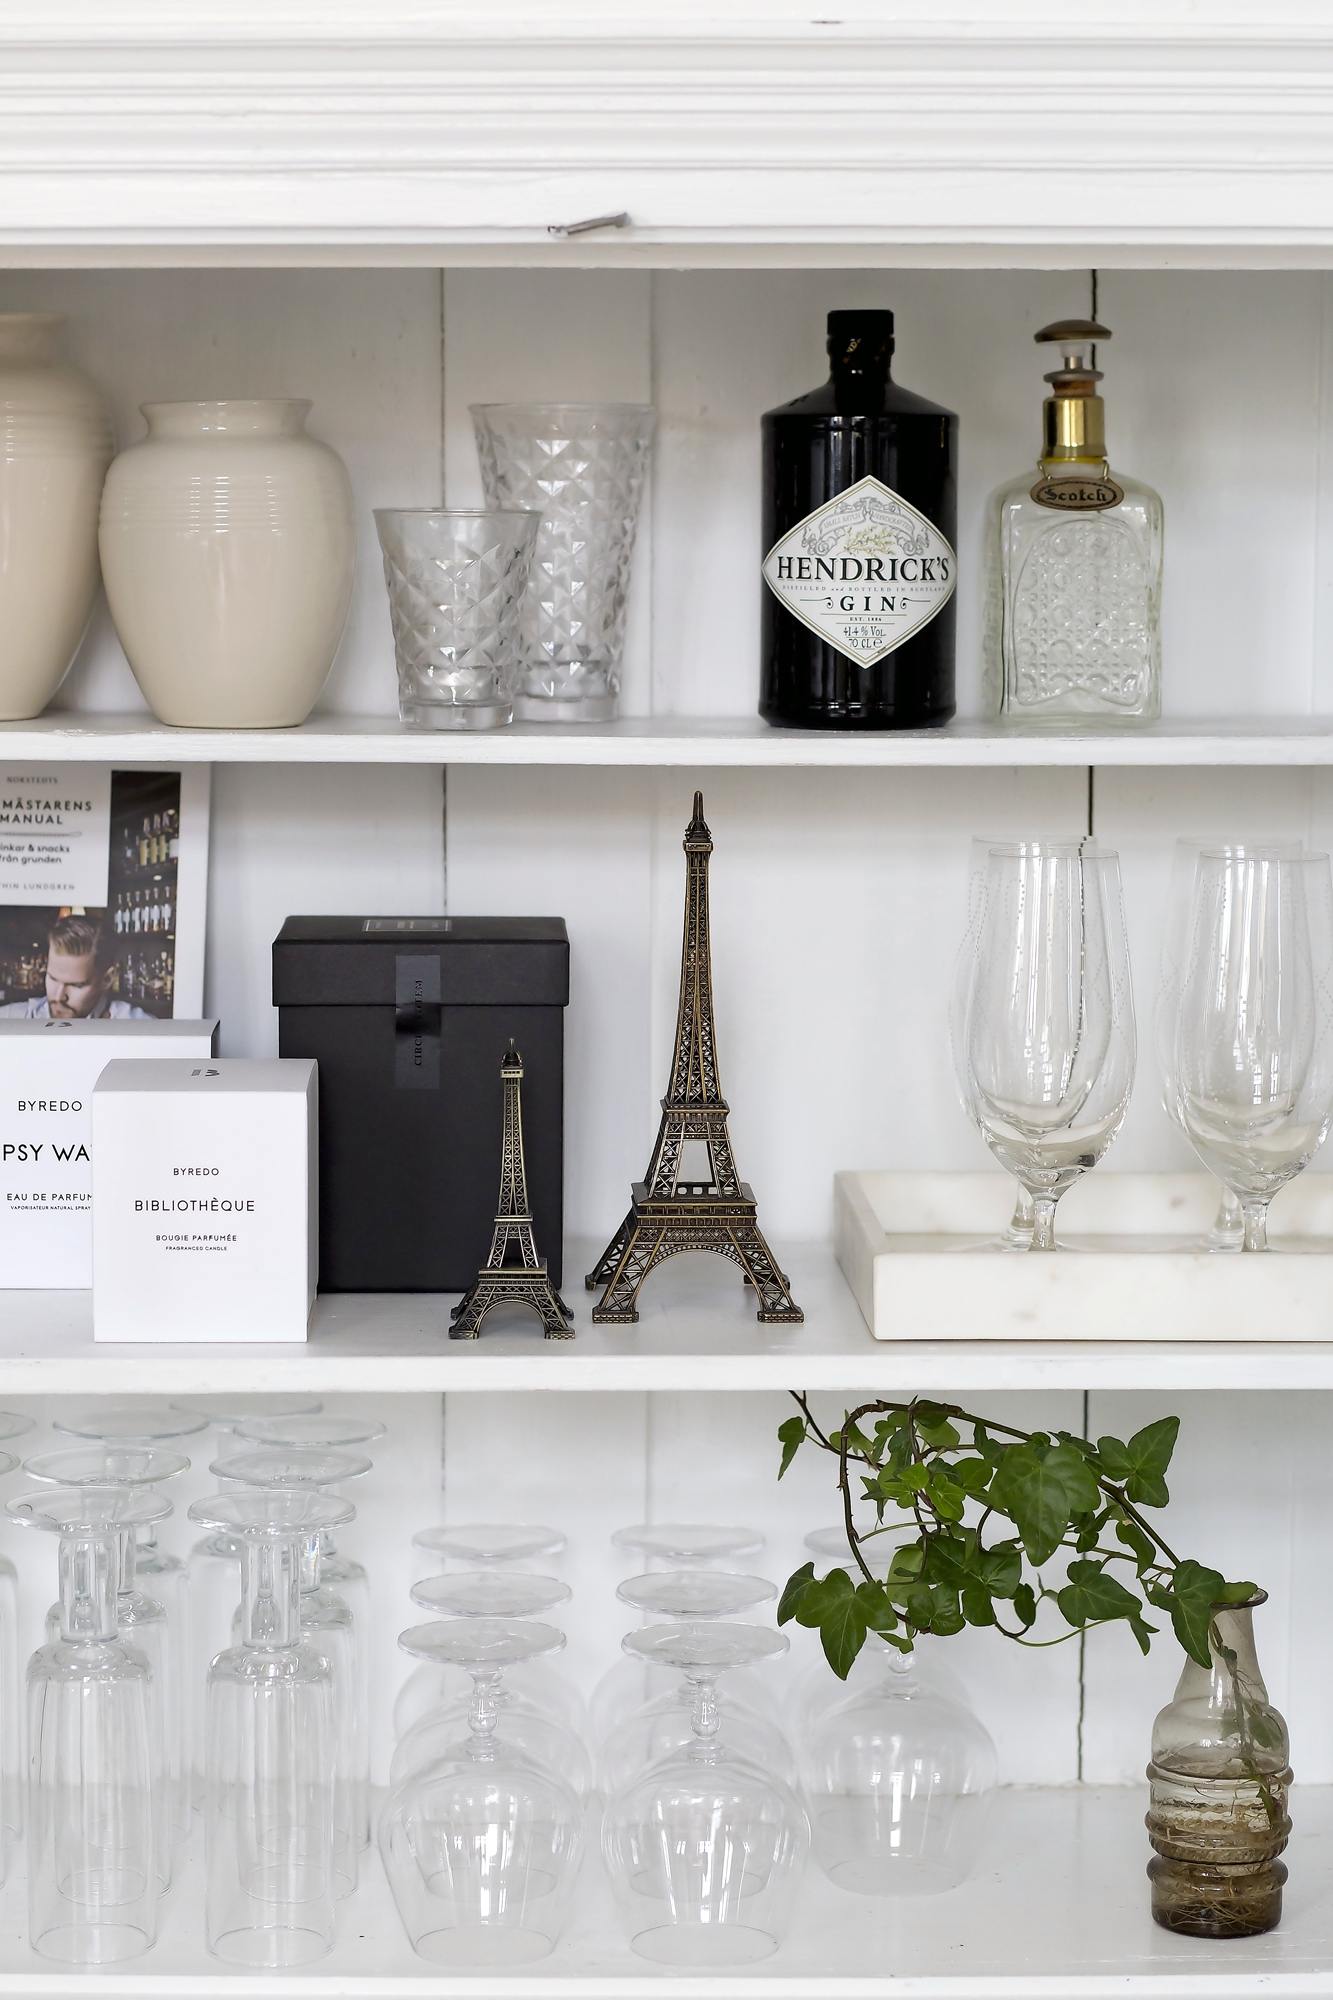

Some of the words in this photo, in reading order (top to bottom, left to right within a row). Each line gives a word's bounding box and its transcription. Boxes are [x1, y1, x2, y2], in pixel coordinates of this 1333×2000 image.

[1044, 488, 1106, 501] Scotch
[777, 556, 949, 582] HENDRICK'S
[840, 596, 896, 611] GIN
[849, 638, 859, 648] 70
[0, 814, 63, 825] MANUAL
[28, 844, 34, 852] &
[37, 844, 70, 853] snacks
[21, 855, 62, 866] grunden
[18, 1100, 82, 1111] BYREDO
[52, 1144, 92, 1161] WA
[173, 1168, 219, 1176] BYREDO
[7, 1193, 28, 1201] EAU
[33, 1193, 47, 1201] DE
[135, 1197, 255, 1211] BIBLIOTHÈQUE
